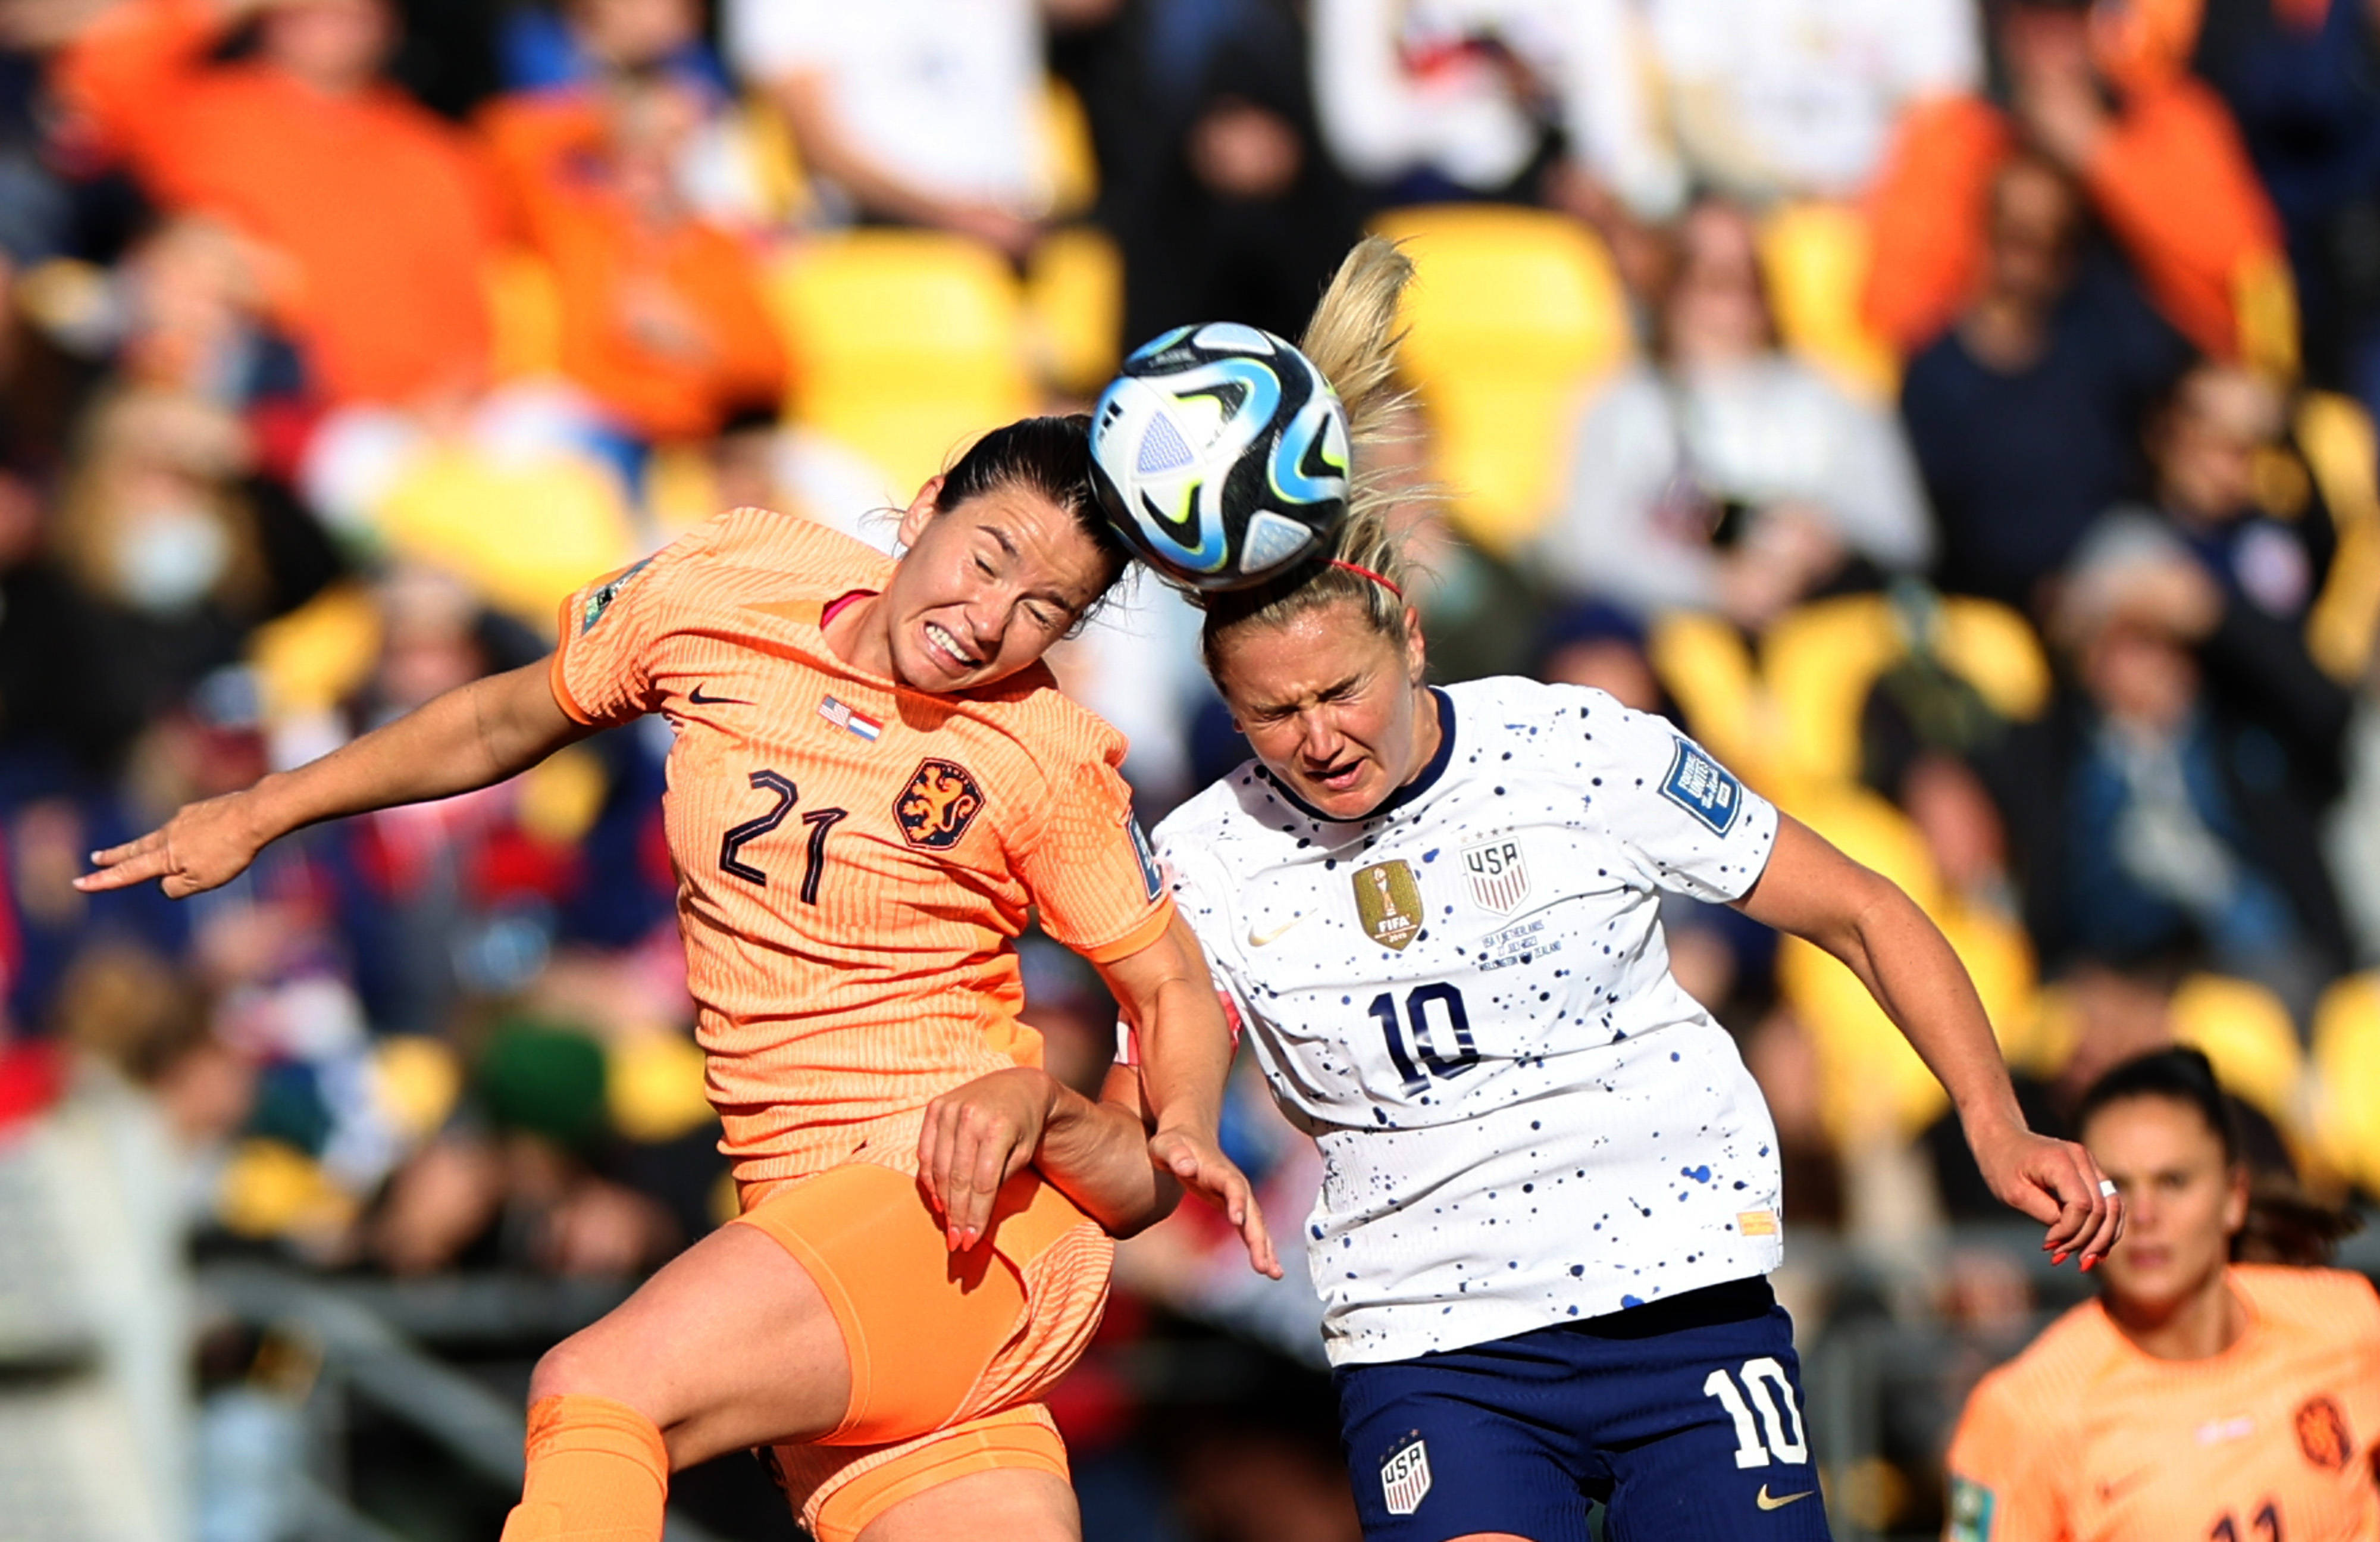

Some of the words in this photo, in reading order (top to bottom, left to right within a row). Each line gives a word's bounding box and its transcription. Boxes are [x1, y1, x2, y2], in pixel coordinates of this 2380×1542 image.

[719, 769, 848, 906] 21
[1467, 843, 1517, 875] USA
[1379, 916, 1410, 933] FIFA
[1368, 982, 1481, 1100] 10
[1703, 1356, 1808, 1469] 10
[1385, 1446, 1421, 1484] USA
